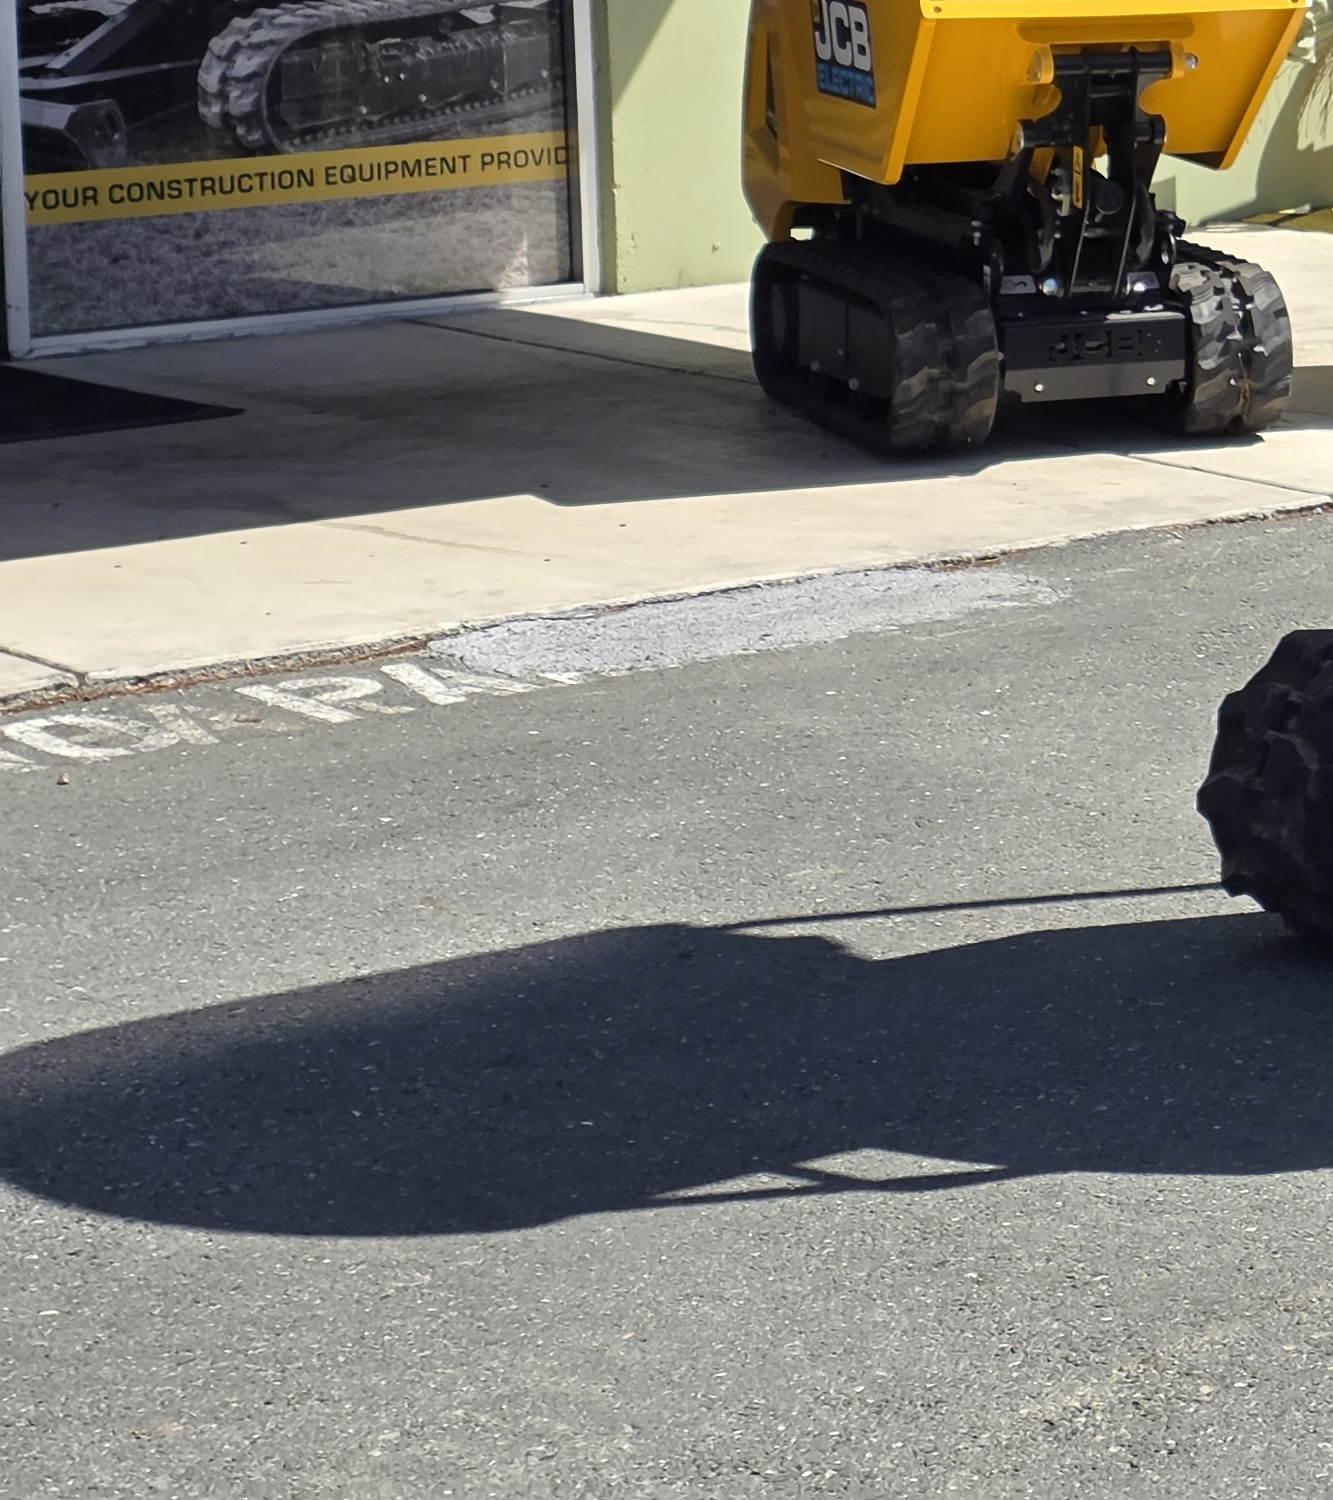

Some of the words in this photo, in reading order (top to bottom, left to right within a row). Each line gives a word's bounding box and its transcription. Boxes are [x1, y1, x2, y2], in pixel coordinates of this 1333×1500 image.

[815, 0, 871, 72] JCB
[23, 186, 99, 211] YOUR
[108, 167, 315, 205] CONSTRUCTION
[324, 154, 471, 186] EQUIPMENT
